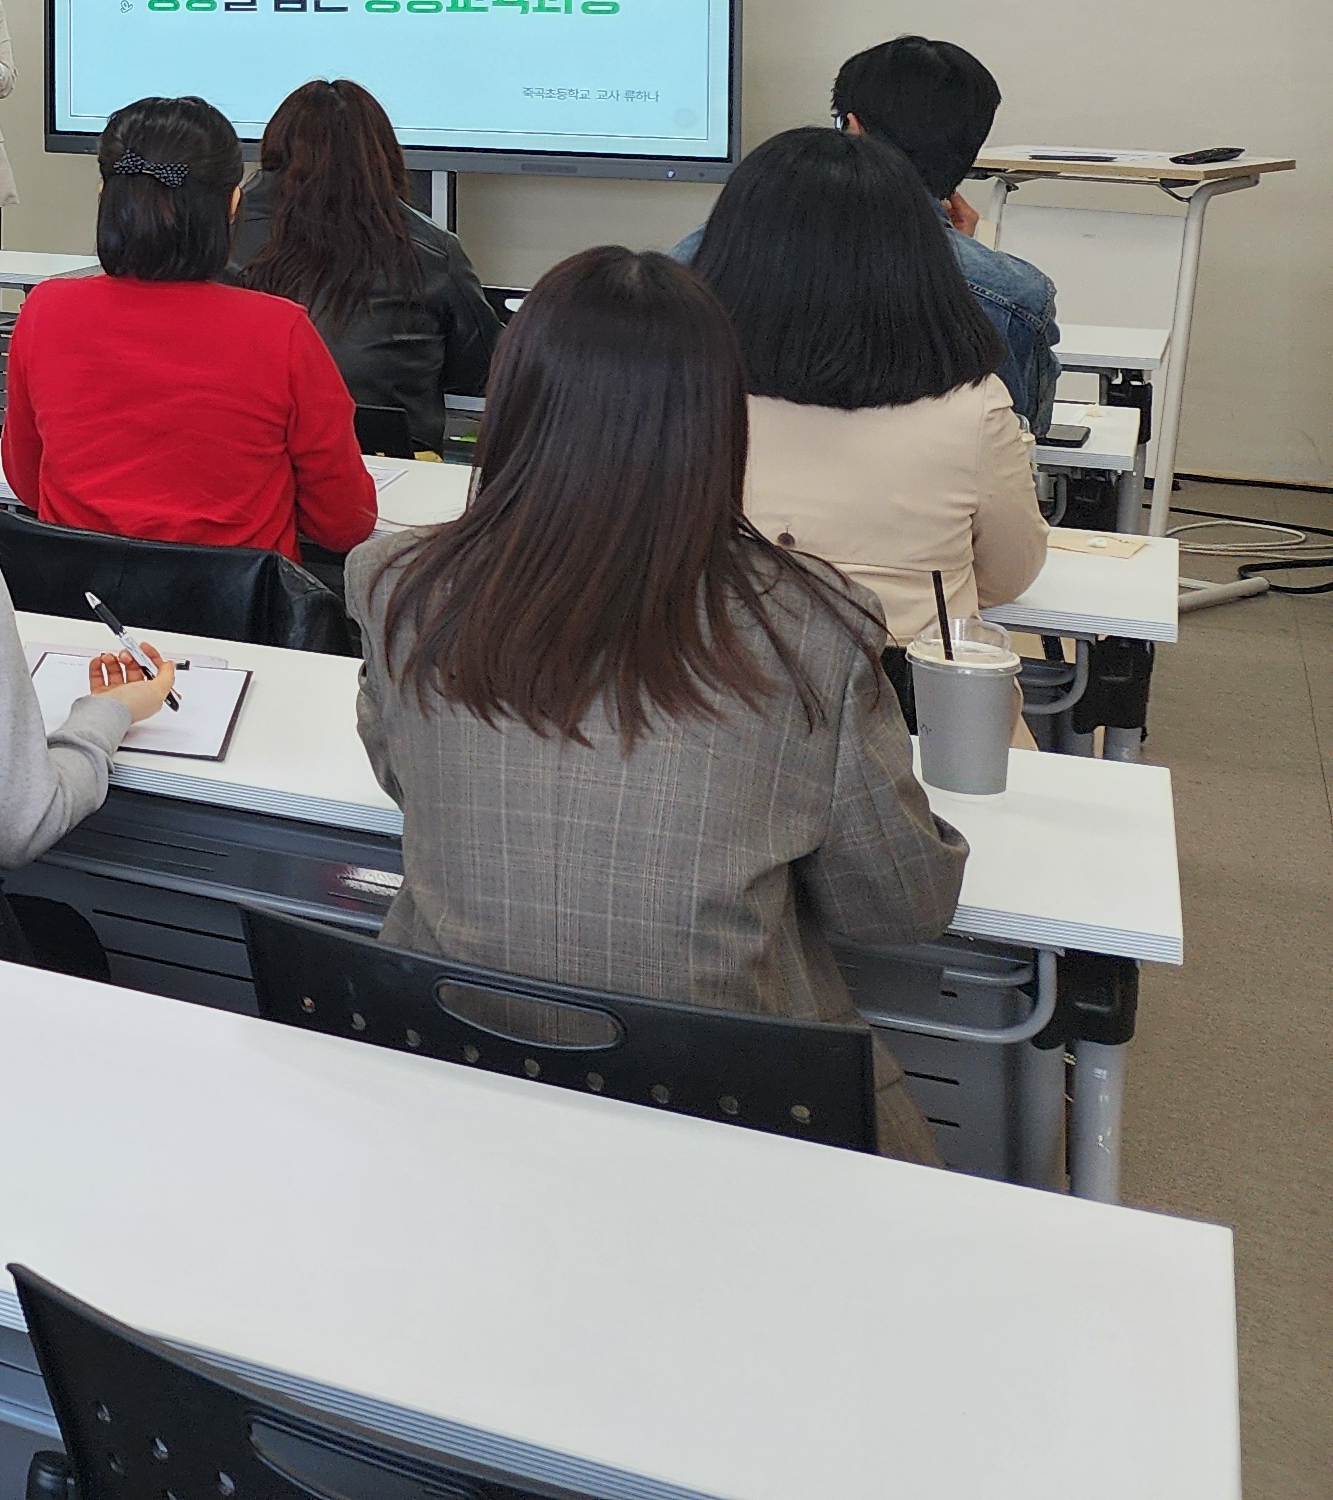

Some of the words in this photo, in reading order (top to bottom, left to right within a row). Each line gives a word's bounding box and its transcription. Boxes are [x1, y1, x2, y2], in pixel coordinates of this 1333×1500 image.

[522, 86, 591, 101] 죽곡초등학교
[595, 89, 621, 102] 교사
[623, 89, 660, 103] 류하나
